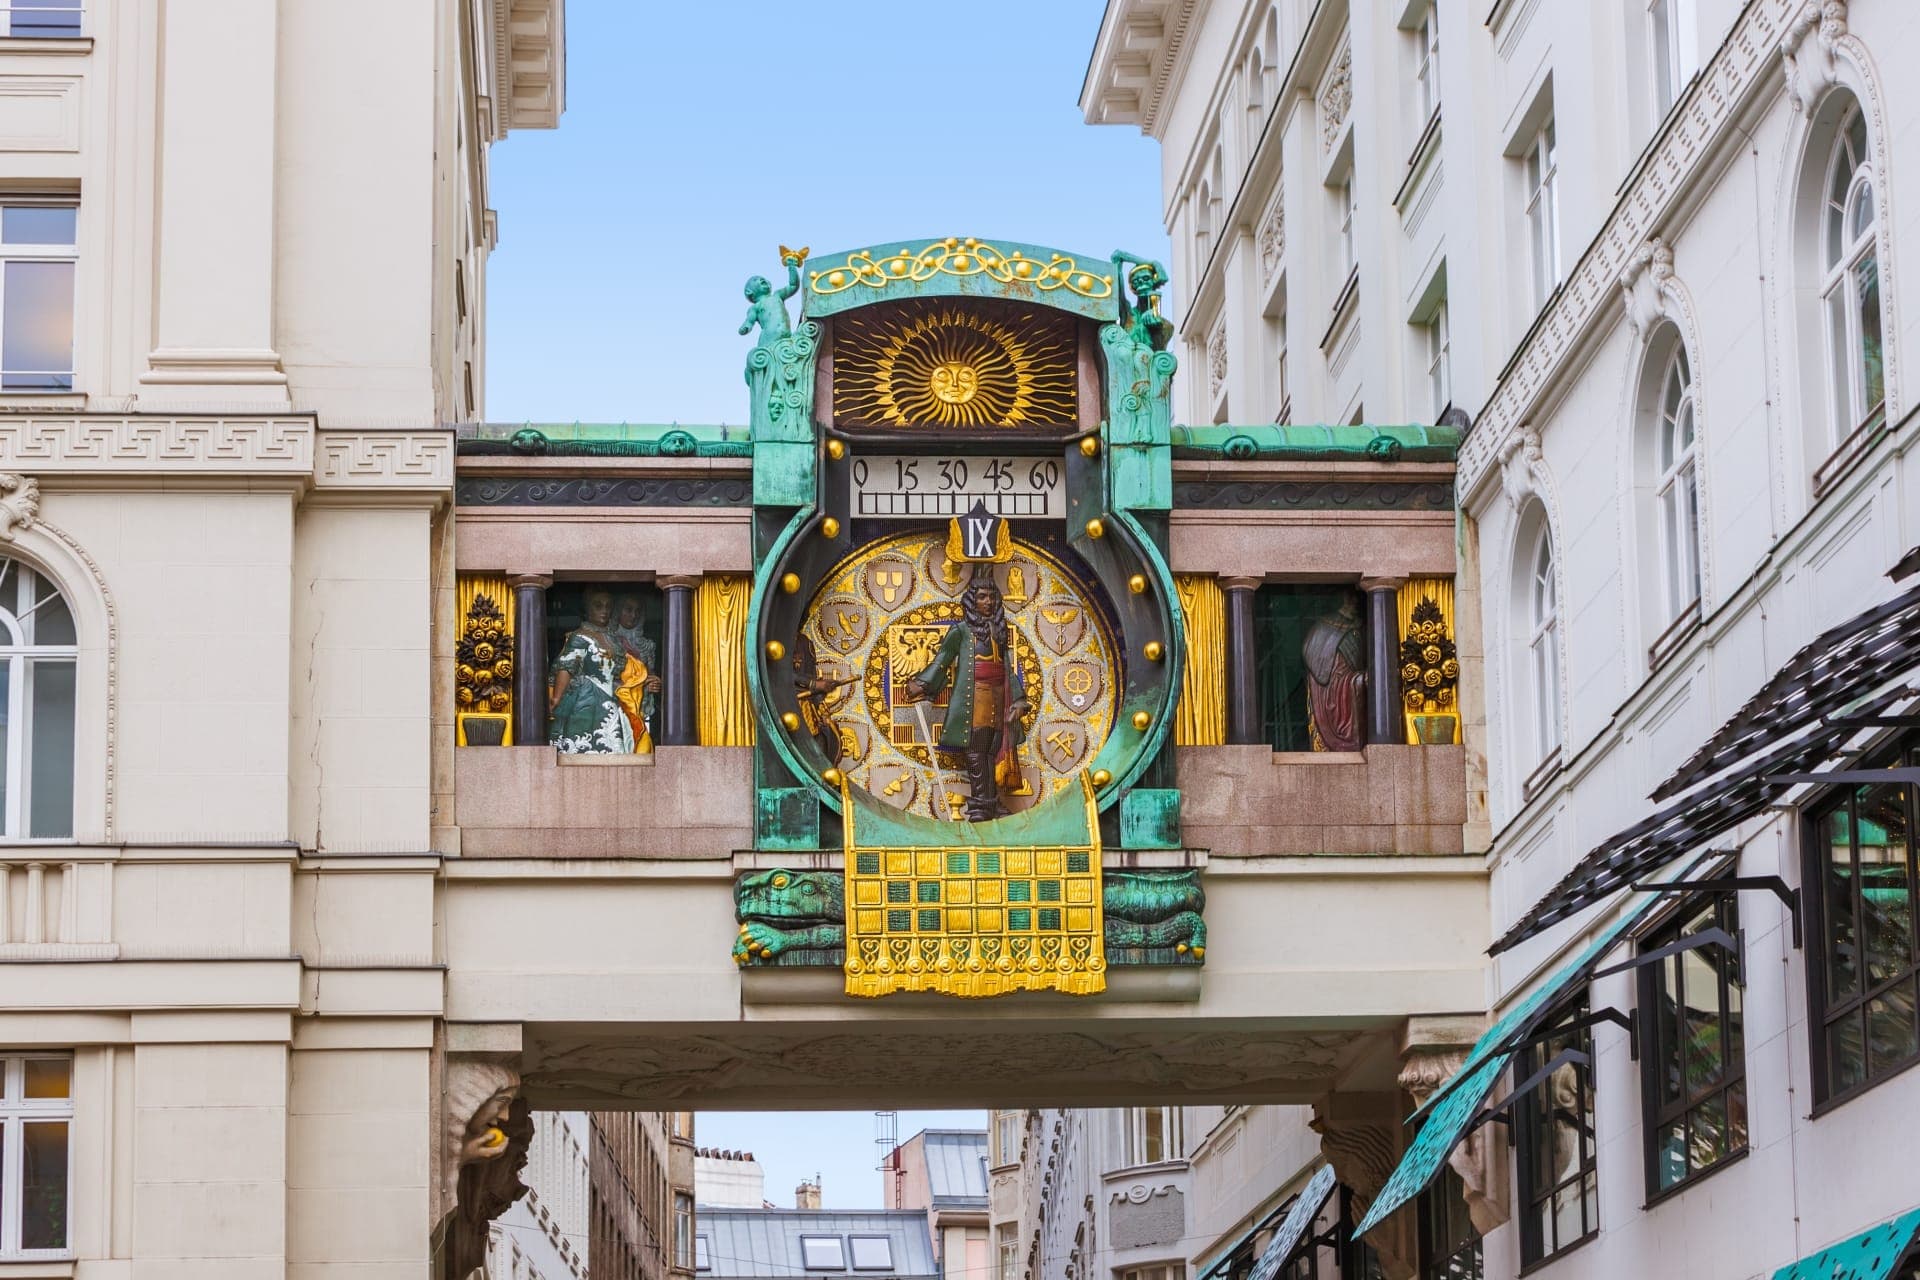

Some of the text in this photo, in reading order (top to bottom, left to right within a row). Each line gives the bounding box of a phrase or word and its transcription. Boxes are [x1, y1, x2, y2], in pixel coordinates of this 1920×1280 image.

[853, 459, 1059, 491] 0 15 30 45 60
[968, 518, 994, 557] IX
